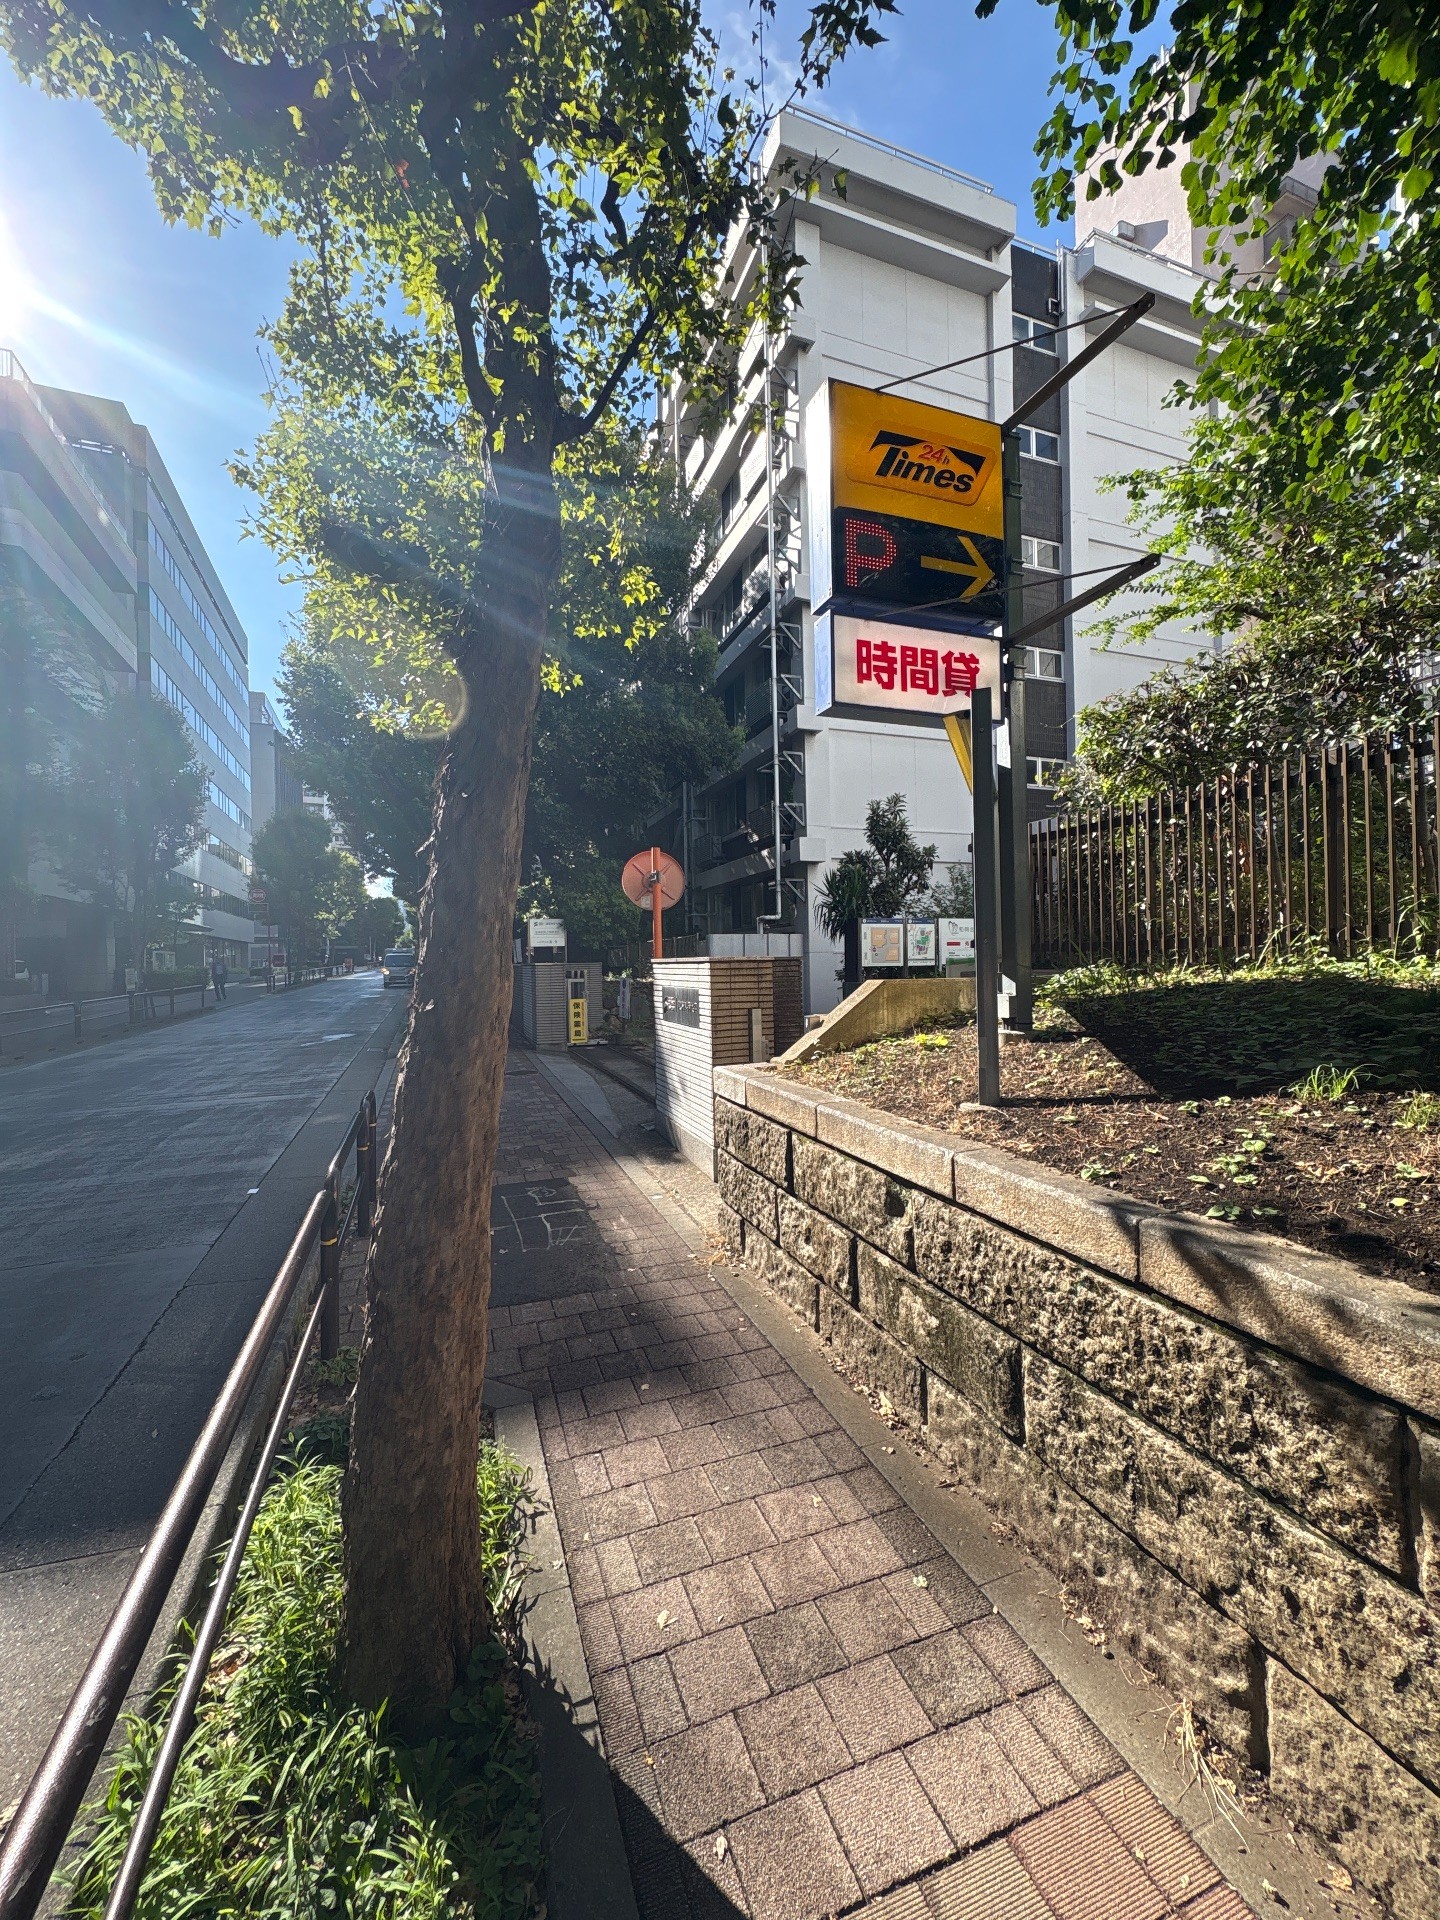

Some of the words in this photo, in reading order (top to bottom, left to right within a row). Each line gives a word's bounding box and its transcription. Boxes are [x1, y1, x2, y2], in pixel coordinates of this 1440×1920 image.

[869, 430, 975, 493] Times
[918, 444, 950, 465] 24h
[845, 518, 897, 588] P
[856, 638, 980, 698] 時間貸
[572, 1001, 582, 1037] 保険薬局
